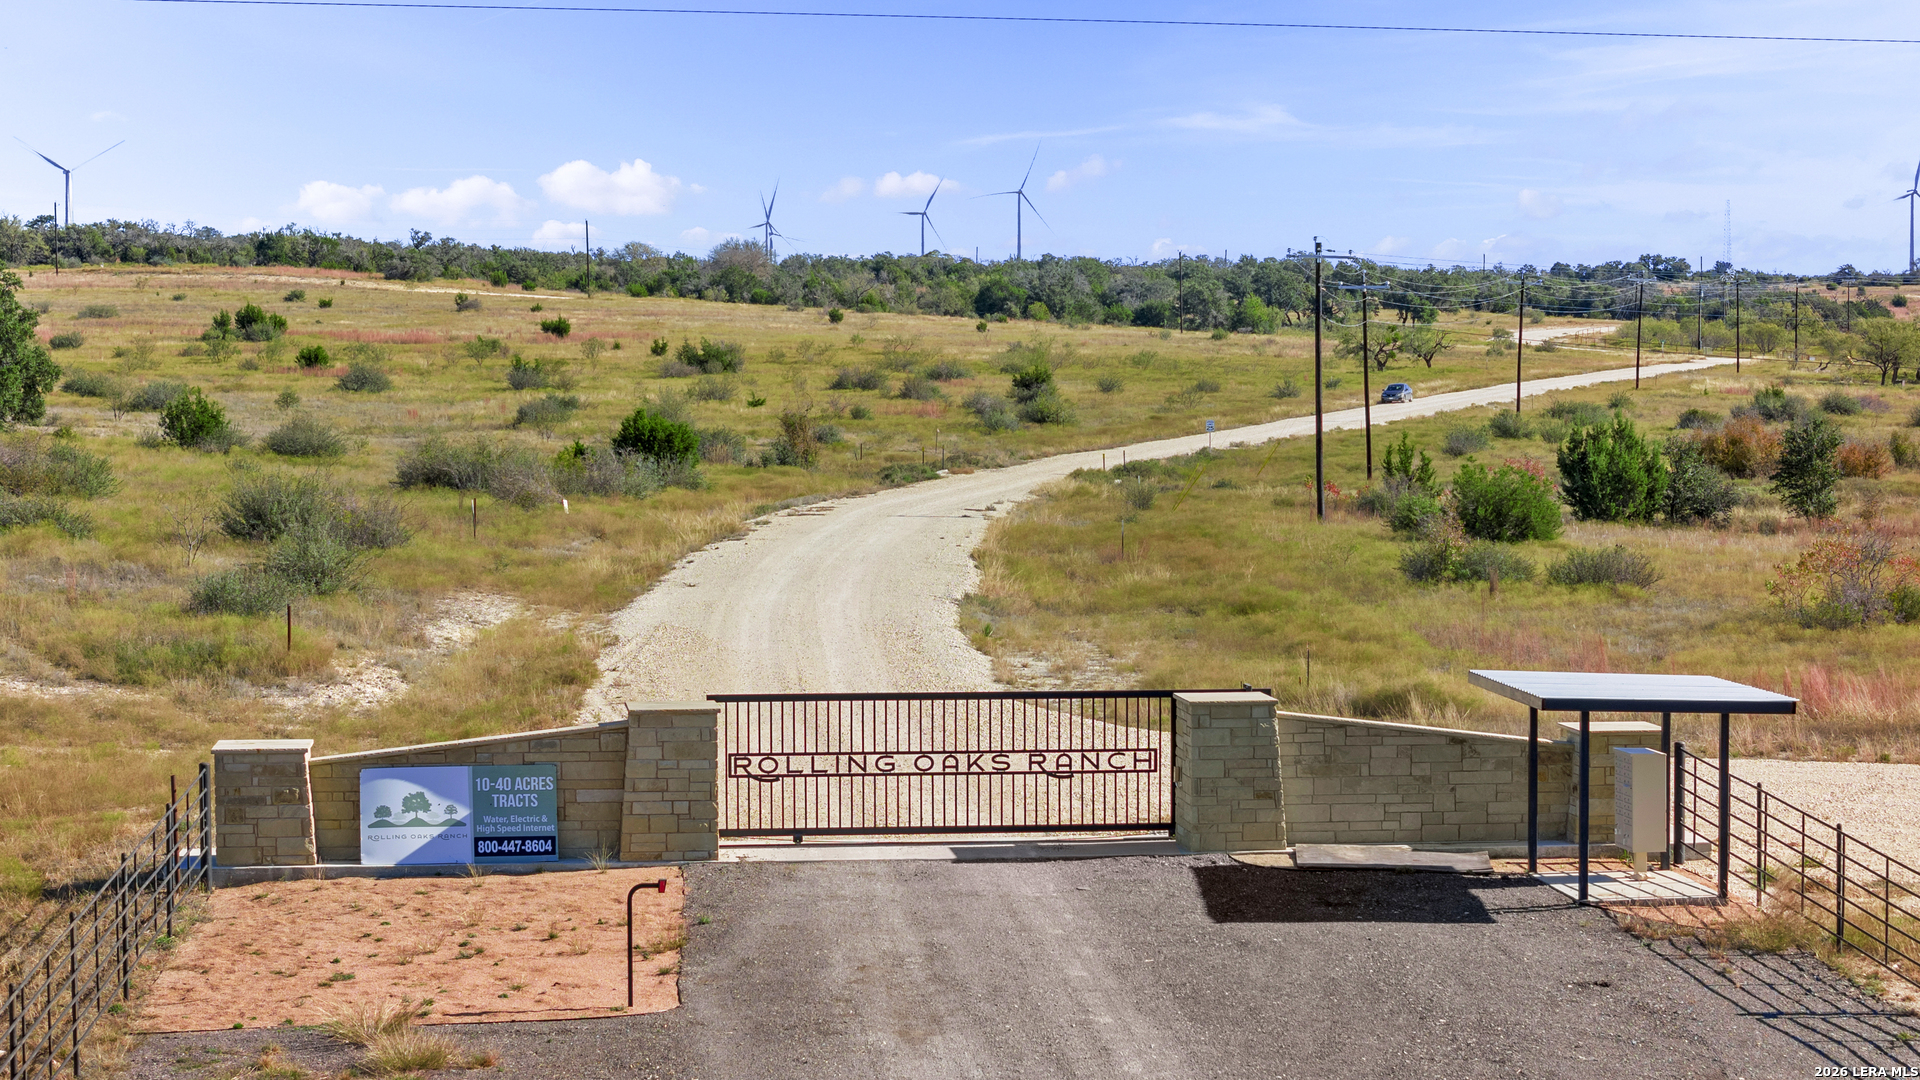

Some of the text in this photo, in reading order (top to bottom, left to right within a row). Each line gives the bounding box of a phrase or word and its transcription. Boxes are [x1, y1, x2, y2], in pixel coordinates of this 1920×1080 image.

[733, 751, 1151, 782] ROLLING OAKS RANCH
[475, 776, 554, 792] 10-40 ACRES
[491, 793, 539, 808] TRACTS
[482, 814, 548, 824] Water, Electric &
[476, 824, 555, 835] High Speed Internet
[367, 834, 408, 842] ROLLING
[437, 833, 468, 841] RANCH
[477, 839, 553, 854] 800-447-8604
